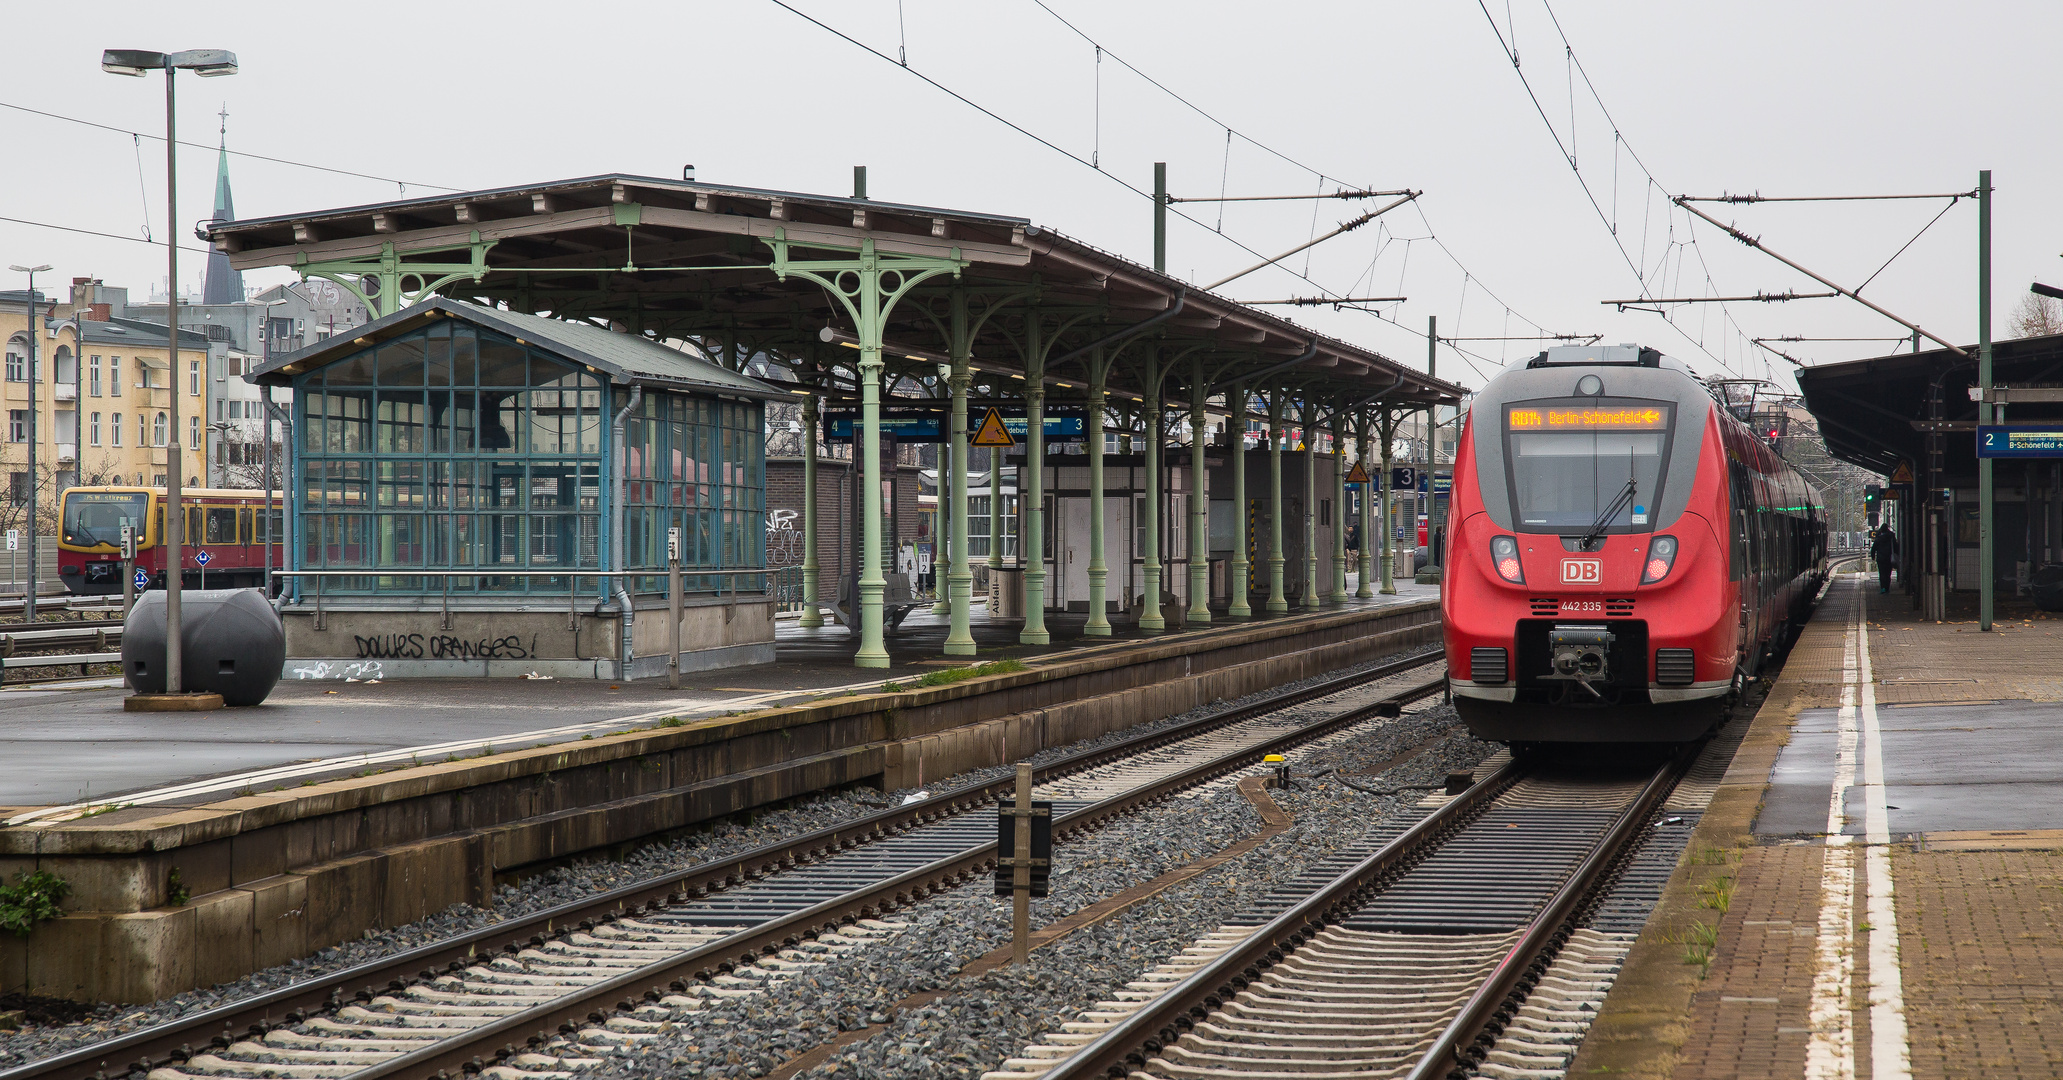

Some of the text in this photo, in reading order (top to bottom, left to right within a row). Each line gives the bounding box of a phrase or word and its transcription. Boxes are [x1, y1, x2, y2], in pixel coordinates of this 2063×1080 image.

[1075, 418, 1083, 430] 3
[1511, 410, 1641, 426] RB14 Berlin-Schönefeld
[831, 420, 839, 432] 4
[1985, 433, 1994, 446] 2
[1401, 468, 1412, 485] 3
[9, 531, 16, 539] 11
[9, 541, 15, 549] 2
[1863, 539, 1871, 550] H
[921, 554, 928, 562] 11
[921, 564, 927, 573] 2
[1566, 562, 1597, 580] DB
[992, 583, 1000, 614] Abfall
[1561, 601, 1601, 611] 442 335
